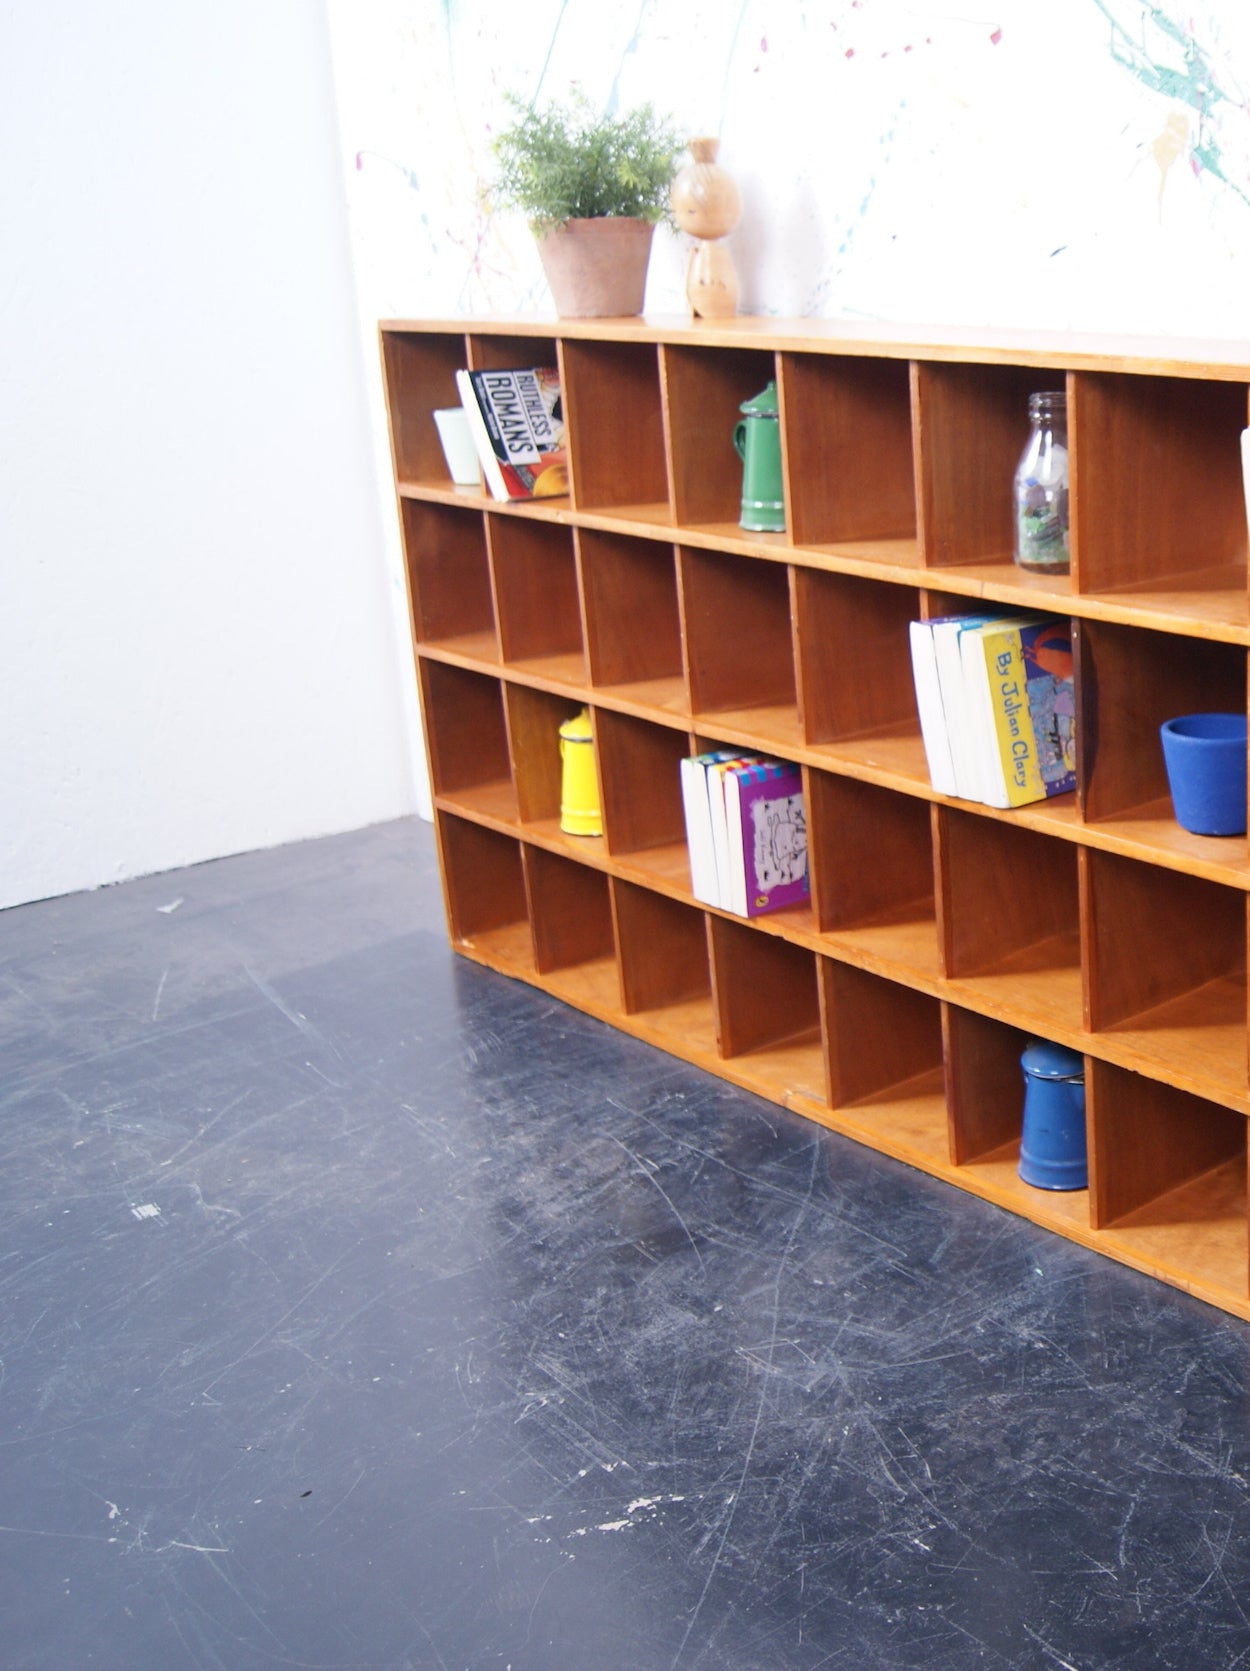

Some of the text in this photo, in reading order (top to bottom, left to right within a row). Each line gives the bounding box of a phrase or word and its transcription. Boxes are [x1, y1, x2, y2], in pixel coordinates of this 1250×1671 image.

[486, 377, 533, 454] ROMANS
[517, 375, 551, 437] RUTHLESS
[997, 652, 1029, 788] By Julian Clary
